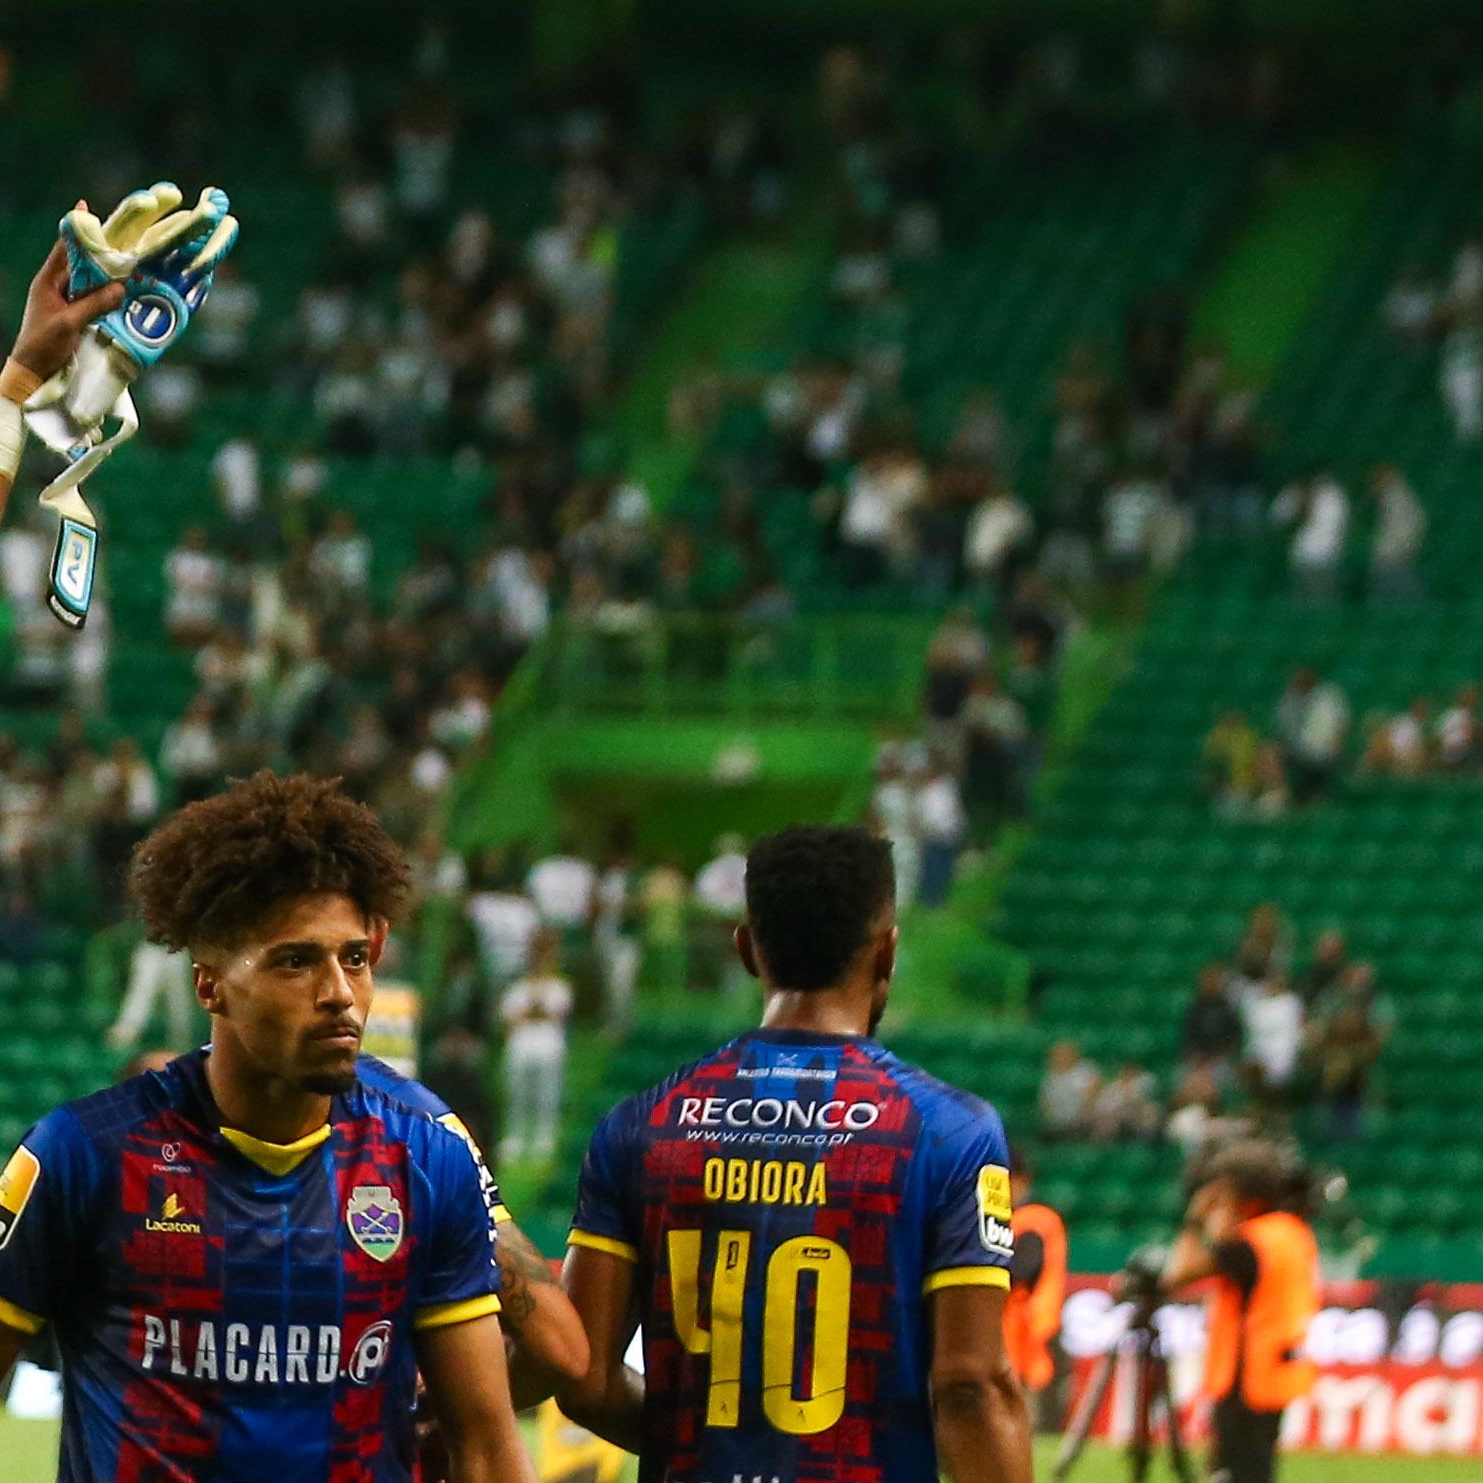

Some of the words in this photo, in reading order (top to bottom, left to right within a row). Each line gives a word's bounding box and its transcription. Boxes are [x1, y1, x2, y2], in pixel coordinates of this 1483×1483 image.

[678, 1096, 880, 1131] RECONCO
[686, 1129, 855, 1148] www.reconco.pt
[704, 1156, 827, 1206] OBIORA
[667, 1229, 852, 1435] 40
